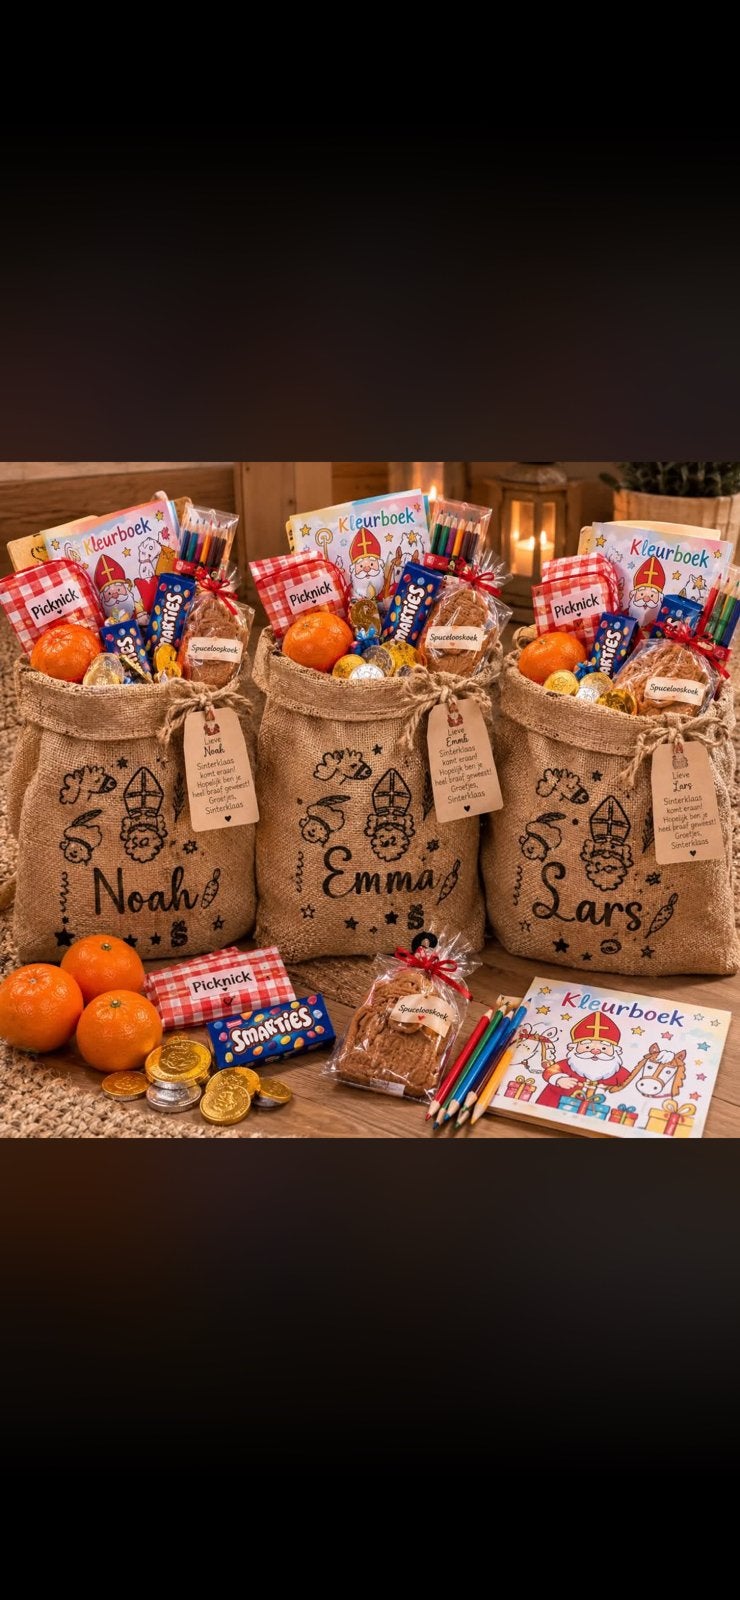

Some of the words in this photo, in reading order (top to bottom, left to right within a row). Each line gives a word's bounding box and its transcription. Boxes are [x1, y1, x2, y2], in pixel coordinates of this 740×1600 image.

[338, 506, 415, 533] Kleurboek
[83, 517, 152, 557] Kleurboek
[629, 538, 710, 569] Kleurboek
[289, 582, 333, 607] Picknick
[31, 587, 80, 621] Picknick
[553, 593, 600, 619] Picknick
[448, 728, 464, 736] Lieve
[204, 737, 221, 745] Lieve
[439, 746, 475, 757] Sinterklaas
[197, 758, 234, 770] Sinterklaas
[465, 763, 475, 771] ben
[478, 763, 483, 771] je
[223, 776, 234, 784] ben
[236, 775, 242, 783] je
[672, 772, 690, 780] Lieve
[447, 791, 485, 804] Sinterklaas
[664, 795, 703, 805] Sinterklaas
[205, 802, 243, 814] Sinterklaas
[671, 838, 709, 849] Sinterklaas
[322, 845, 439, 898] Emma
[93, 866, 199, 915] Noah
[532, 861, 643, 931] Lars
[192, 971, 252, 993] Picknick
[561, 991, 685, 1027] Kleurboek
